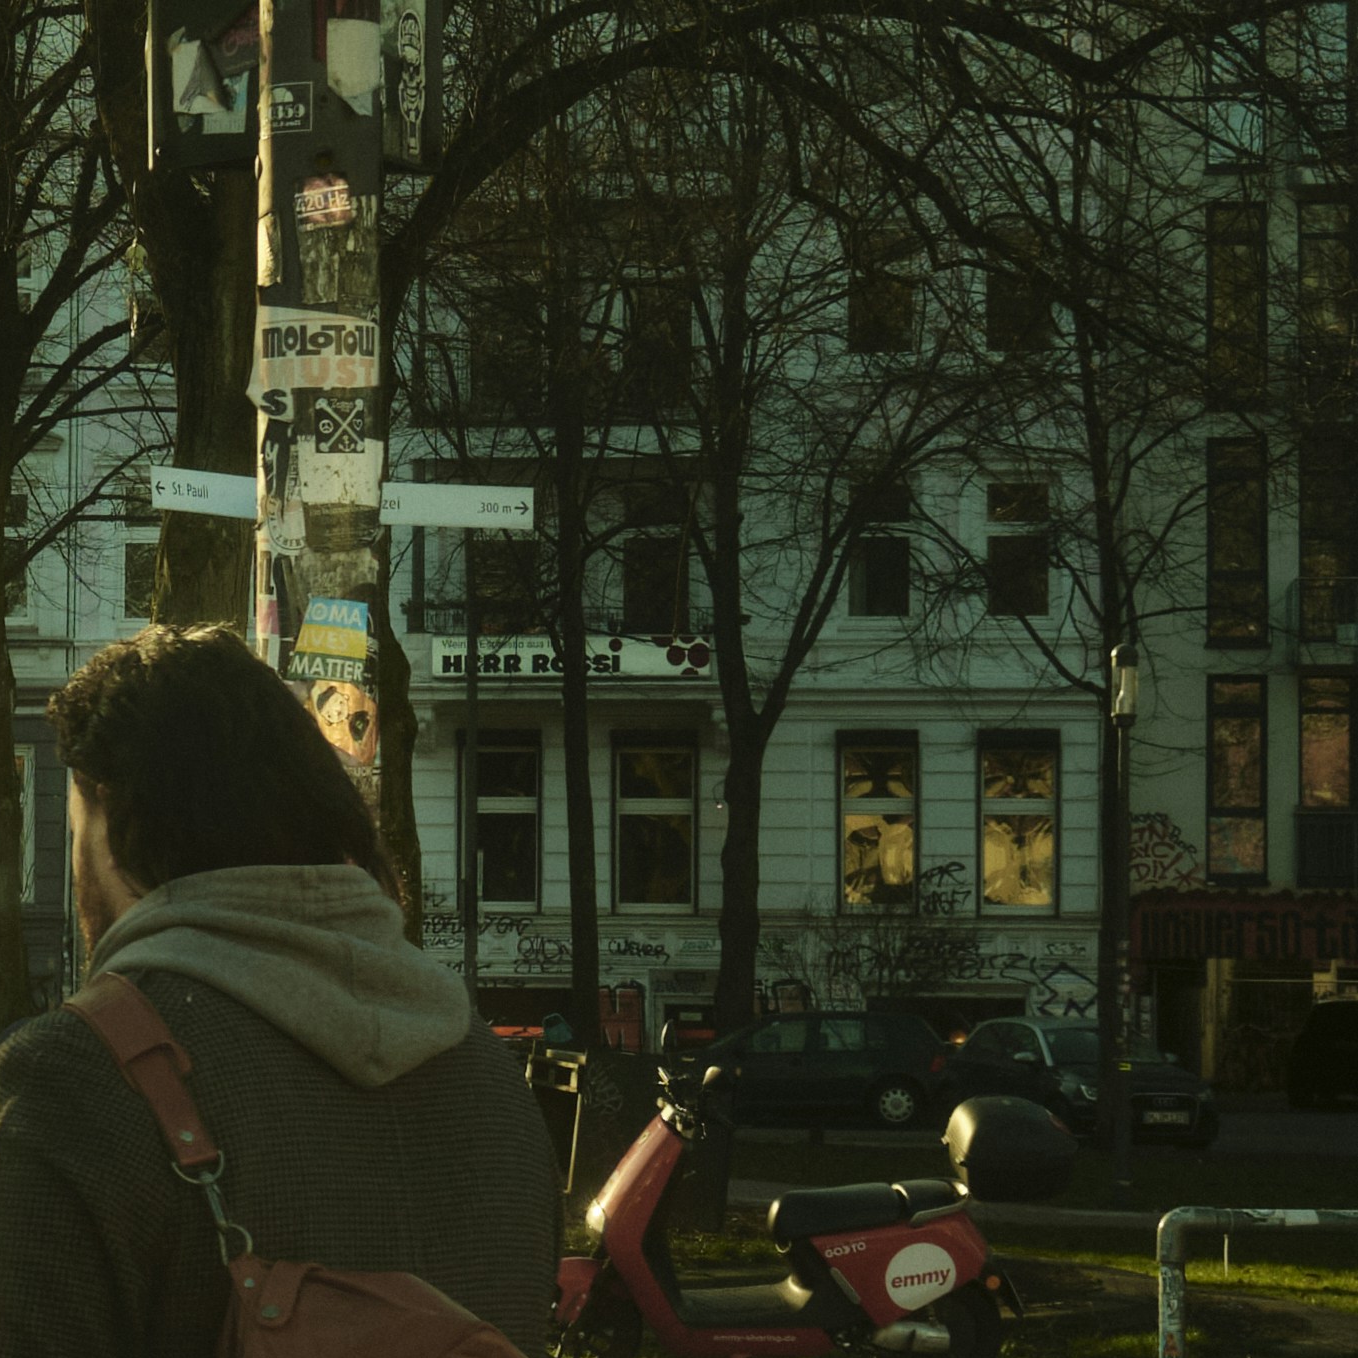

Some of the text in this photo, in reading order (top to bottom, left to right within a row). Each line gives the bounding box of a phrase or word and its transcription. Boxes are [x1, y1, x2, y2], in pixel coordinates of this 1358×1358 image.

[262, 324, 375, 359] MOLOTOW
[171, 484, 209, 499] St. Pauli
[477, 502, 512, 514] 300 m
[300, 629, 350, 651] IVES
[290, 656, 364, 682] MATTER
[891, 1267, 951, 1289] emmy
